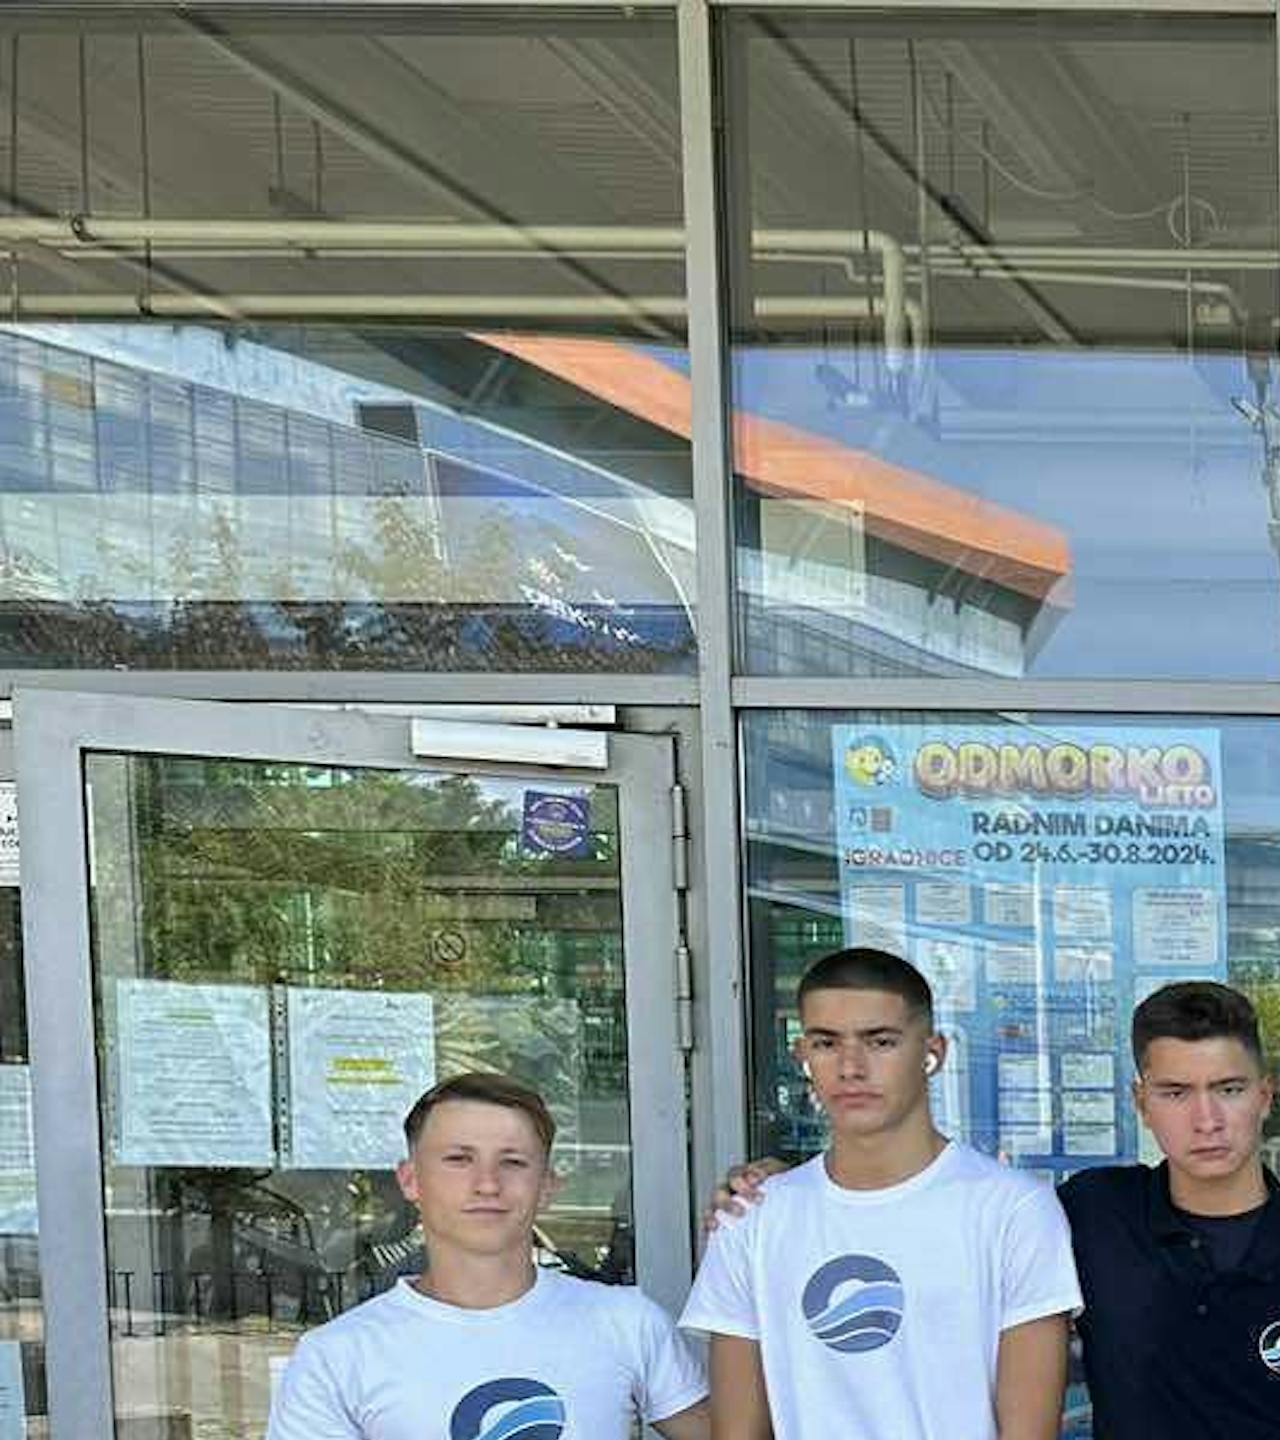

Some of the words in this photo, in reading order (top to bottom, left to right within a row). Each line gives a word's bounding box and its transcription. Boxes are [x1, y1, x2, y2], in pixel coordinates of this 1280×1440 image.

[915, 741, 1208, 796] ODMORKO
[971, 811, 1087, 838] RADNIM
[1094, 814, 1212, 839] DANIMA
[972, 841, 1014, 864] OD
